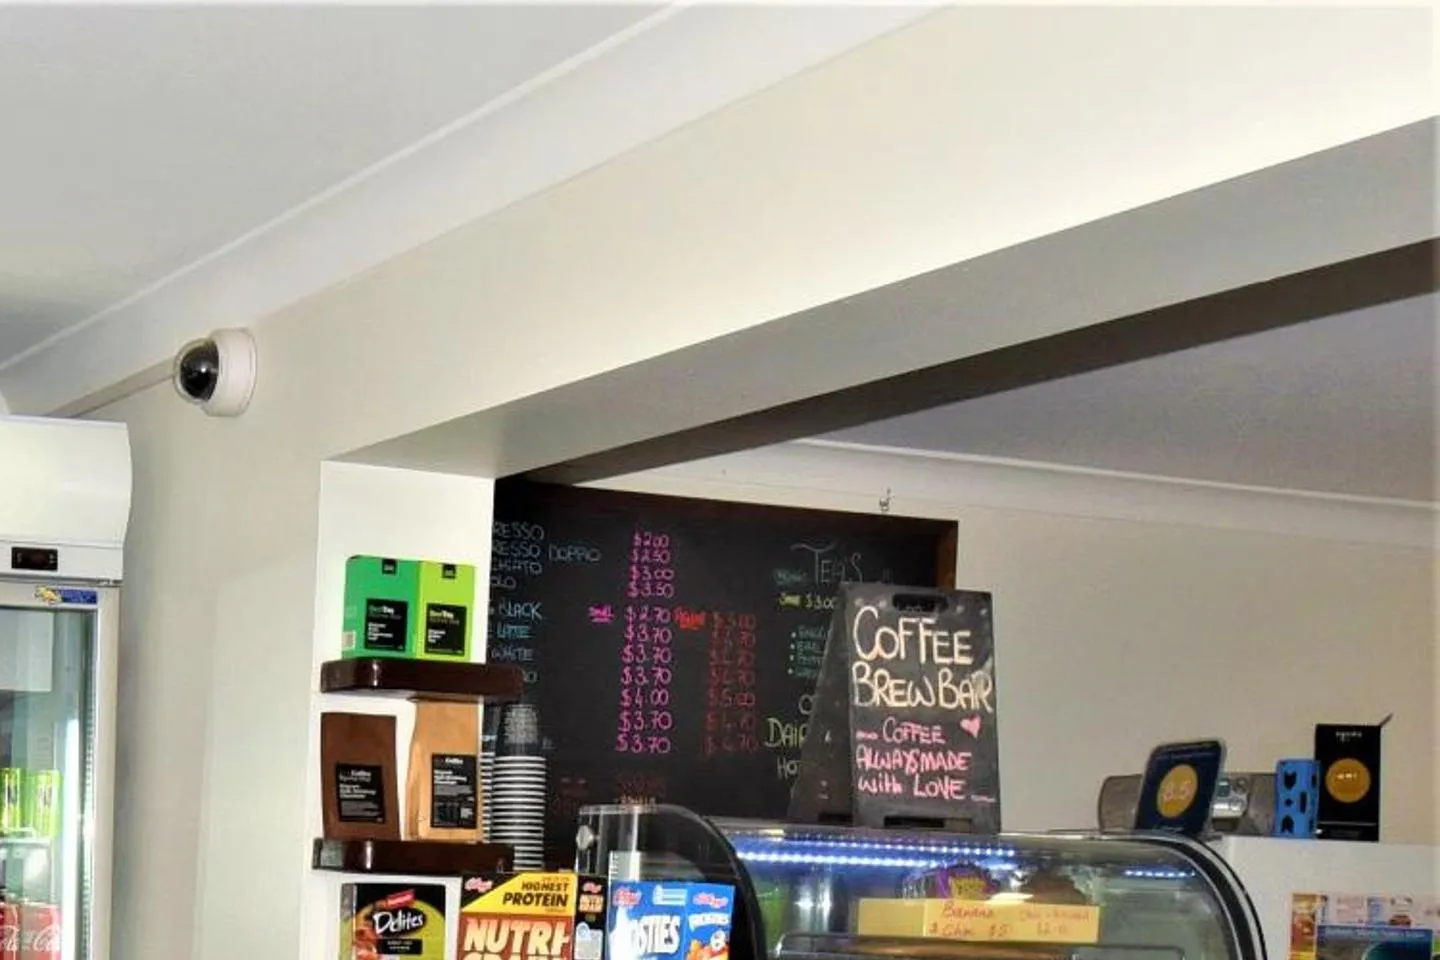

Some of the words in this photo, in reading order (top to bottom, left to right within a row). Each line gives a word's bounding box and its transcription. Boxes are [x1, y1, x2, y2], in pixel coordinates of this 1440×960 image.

[852, 605, 975, 665] COFFEE
[851, 661, 935, 708] BREW
[939, 667, 994, 713] BAR
[882, 715, 947, 744] COFFEE
[913, 778, 966, 799] LOVE
[521, 881, 570, 892] HIGHEST
[503, 892, 569, 907] PROTEIN
